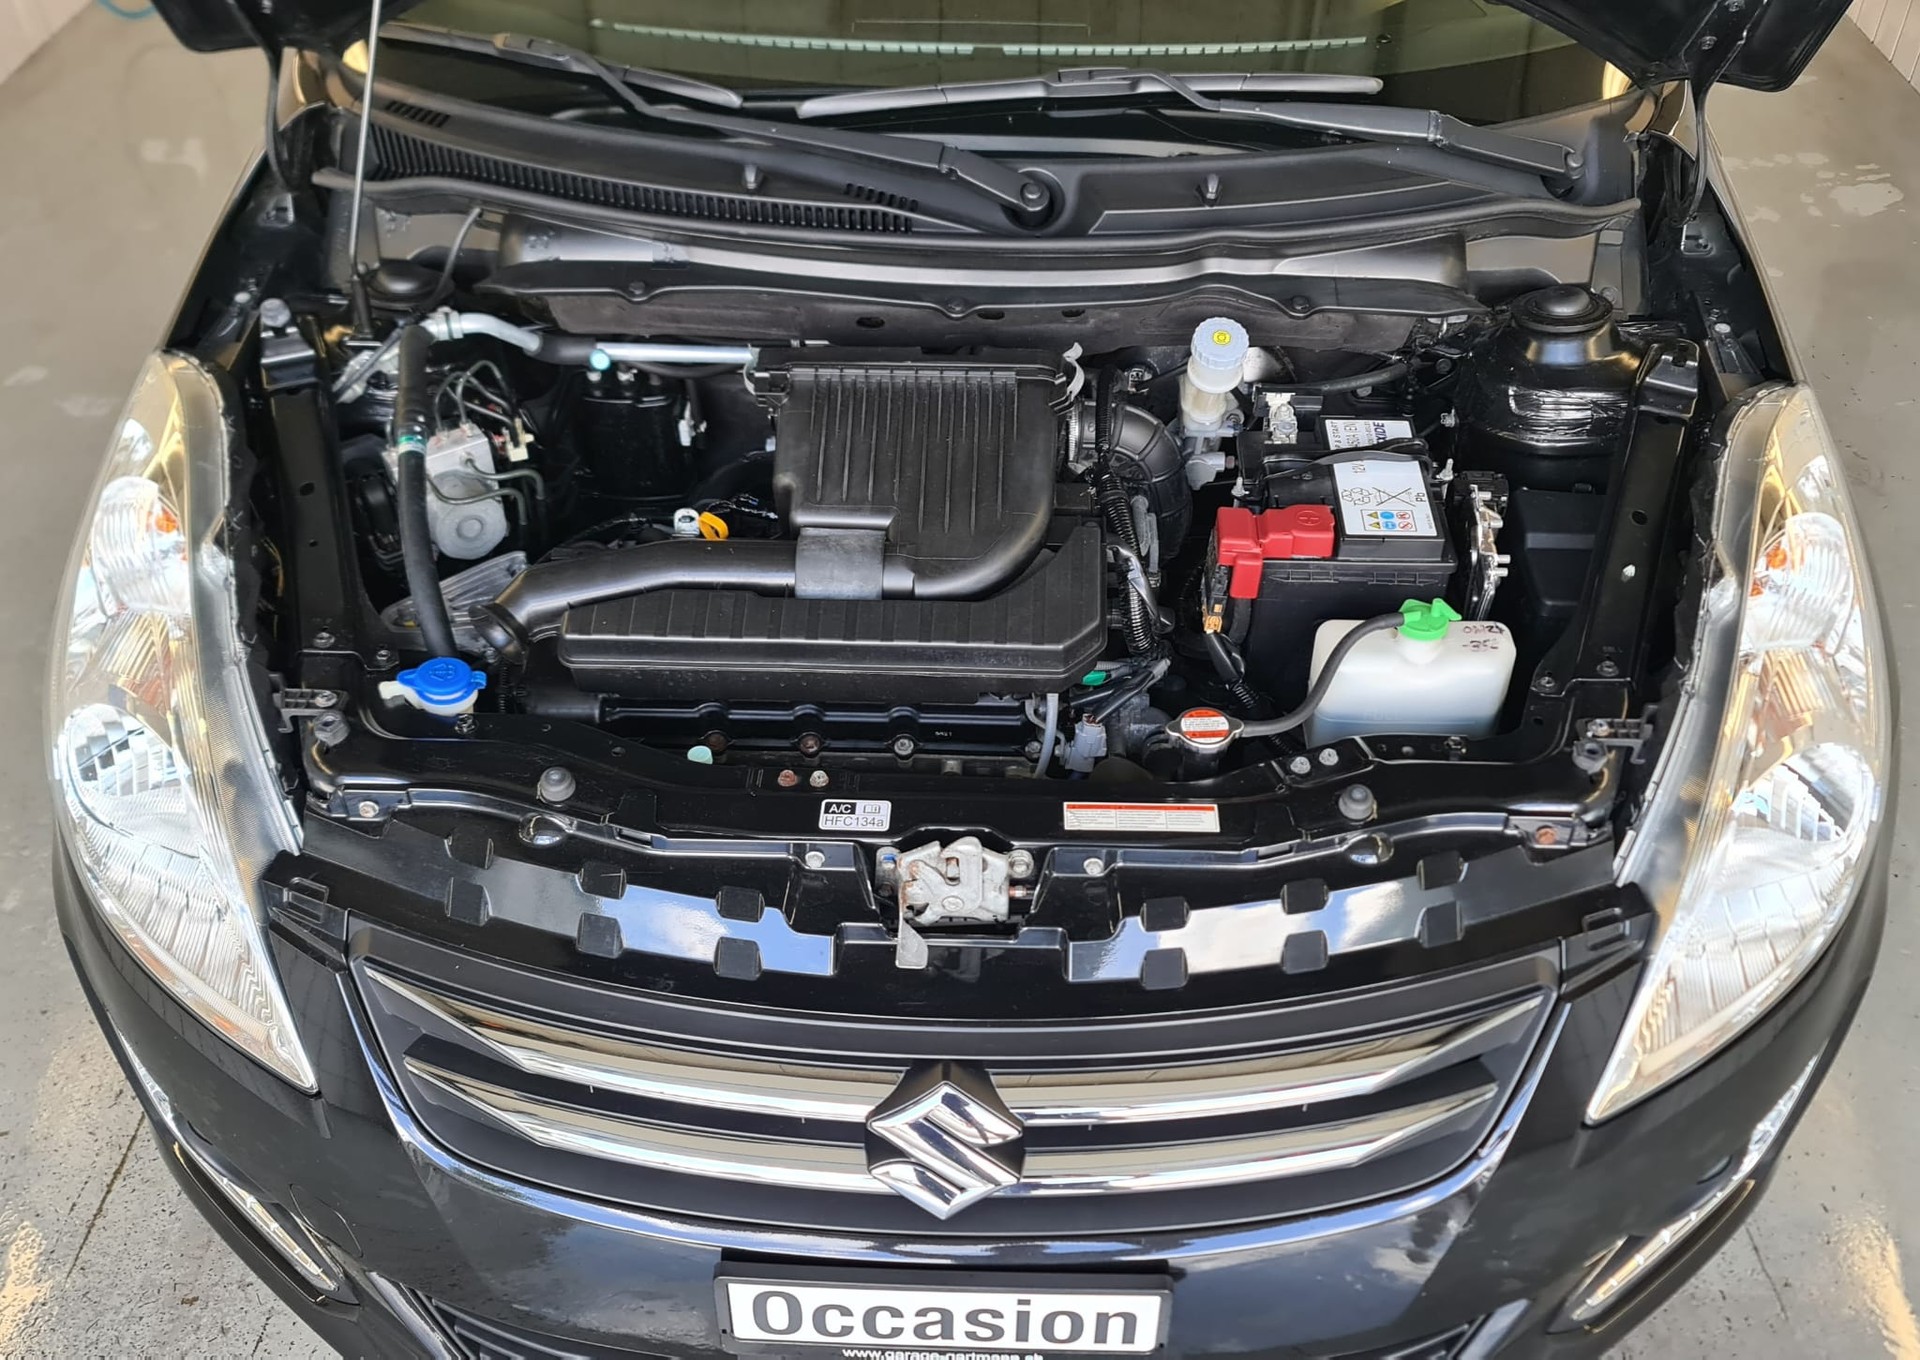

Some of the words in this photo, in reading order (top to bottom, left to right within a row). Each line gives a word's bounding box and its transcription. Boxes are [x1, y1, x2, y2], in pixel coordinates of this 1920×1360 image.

[1330, 421, 1341, 438] START
[1373, 421, 1388, 443] XIDE
[1415, 492, 1427, 503] Pb
[829, 803, 852, 814] A/C
[824, 815, 884, 827] HFC134a
[752, 1290, 1138, 1345] Occasion
